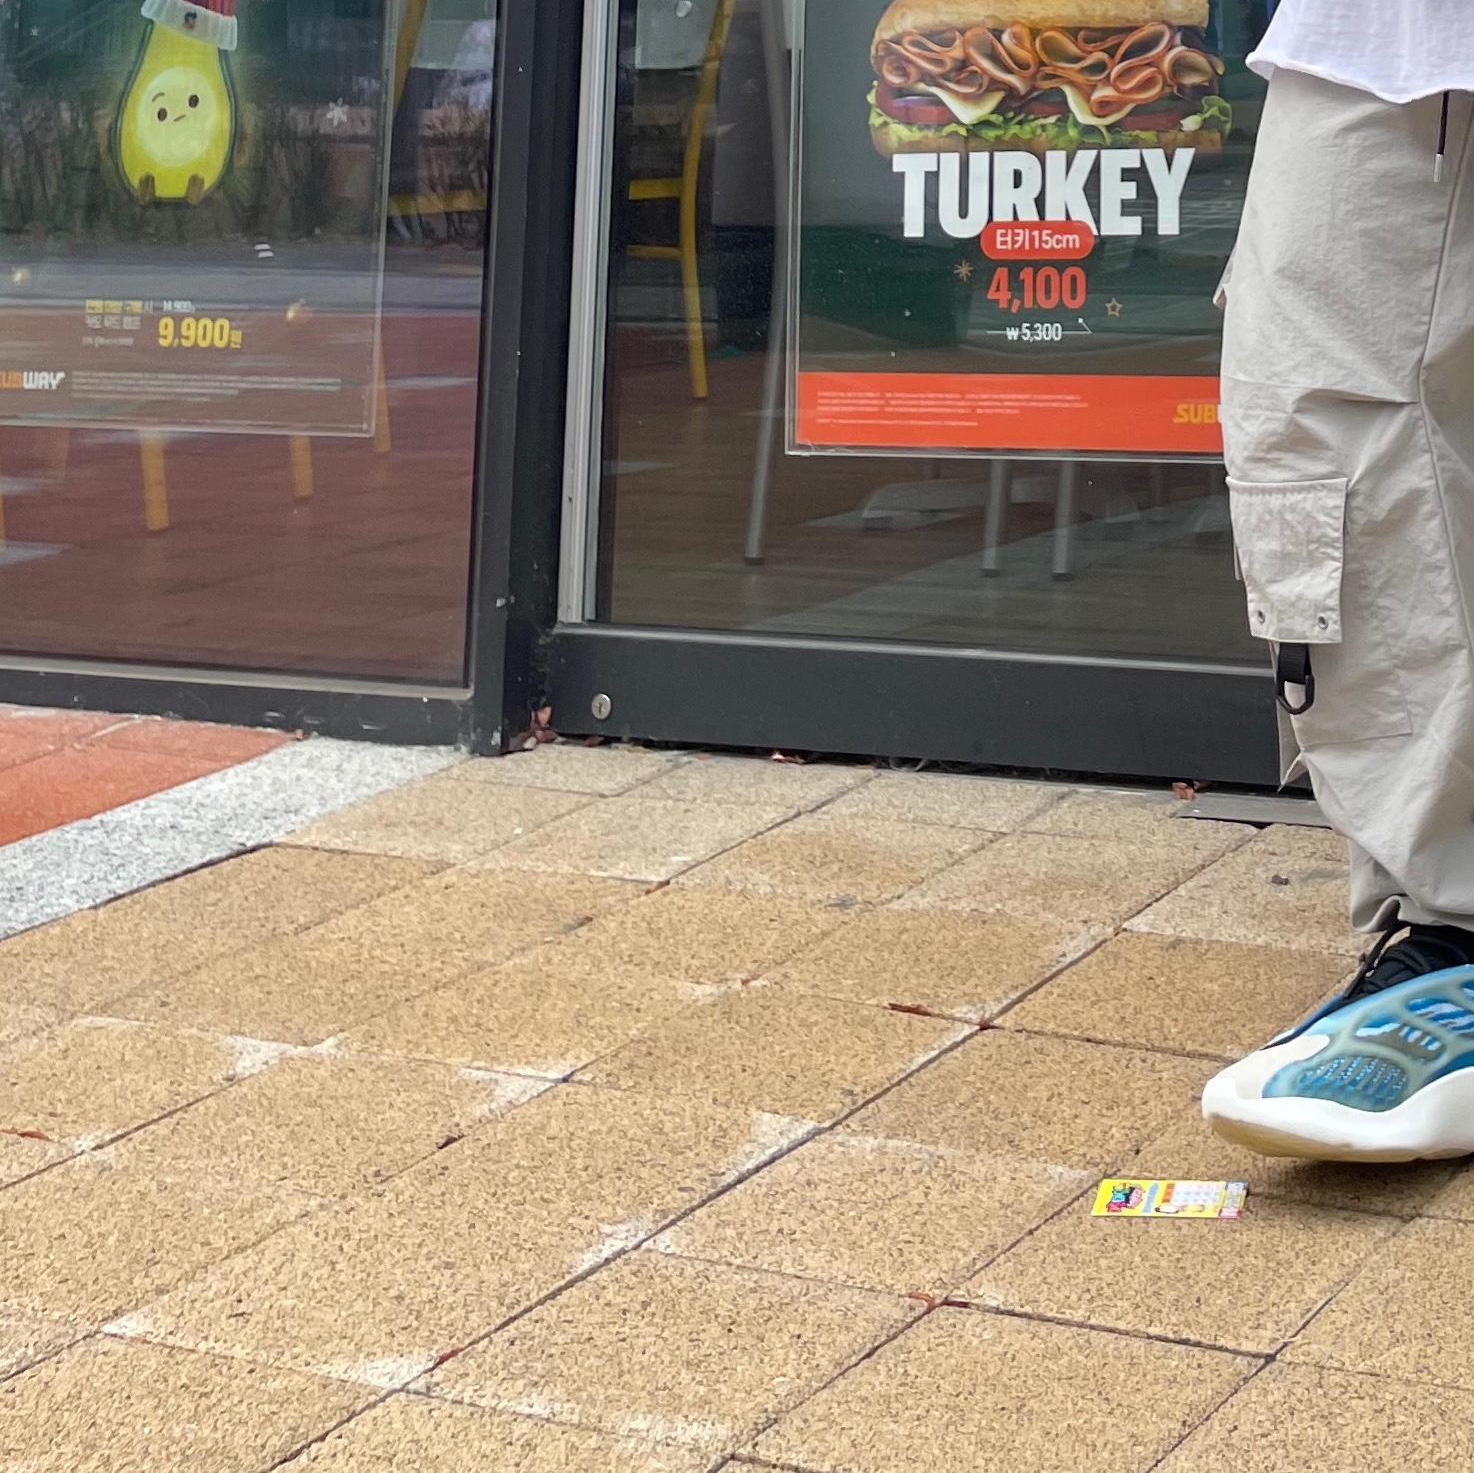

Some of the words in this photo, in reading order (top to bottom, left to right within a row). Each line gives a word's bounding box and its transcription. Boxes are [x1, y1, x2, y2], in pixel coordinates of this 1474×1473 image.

[892, 147, 1196, 239] TURKEY
[987, 266, 1087, 314] 4,100
[0, 371, 65, 389] UBWAY
[1173, 403, 1222, 425] SUB
